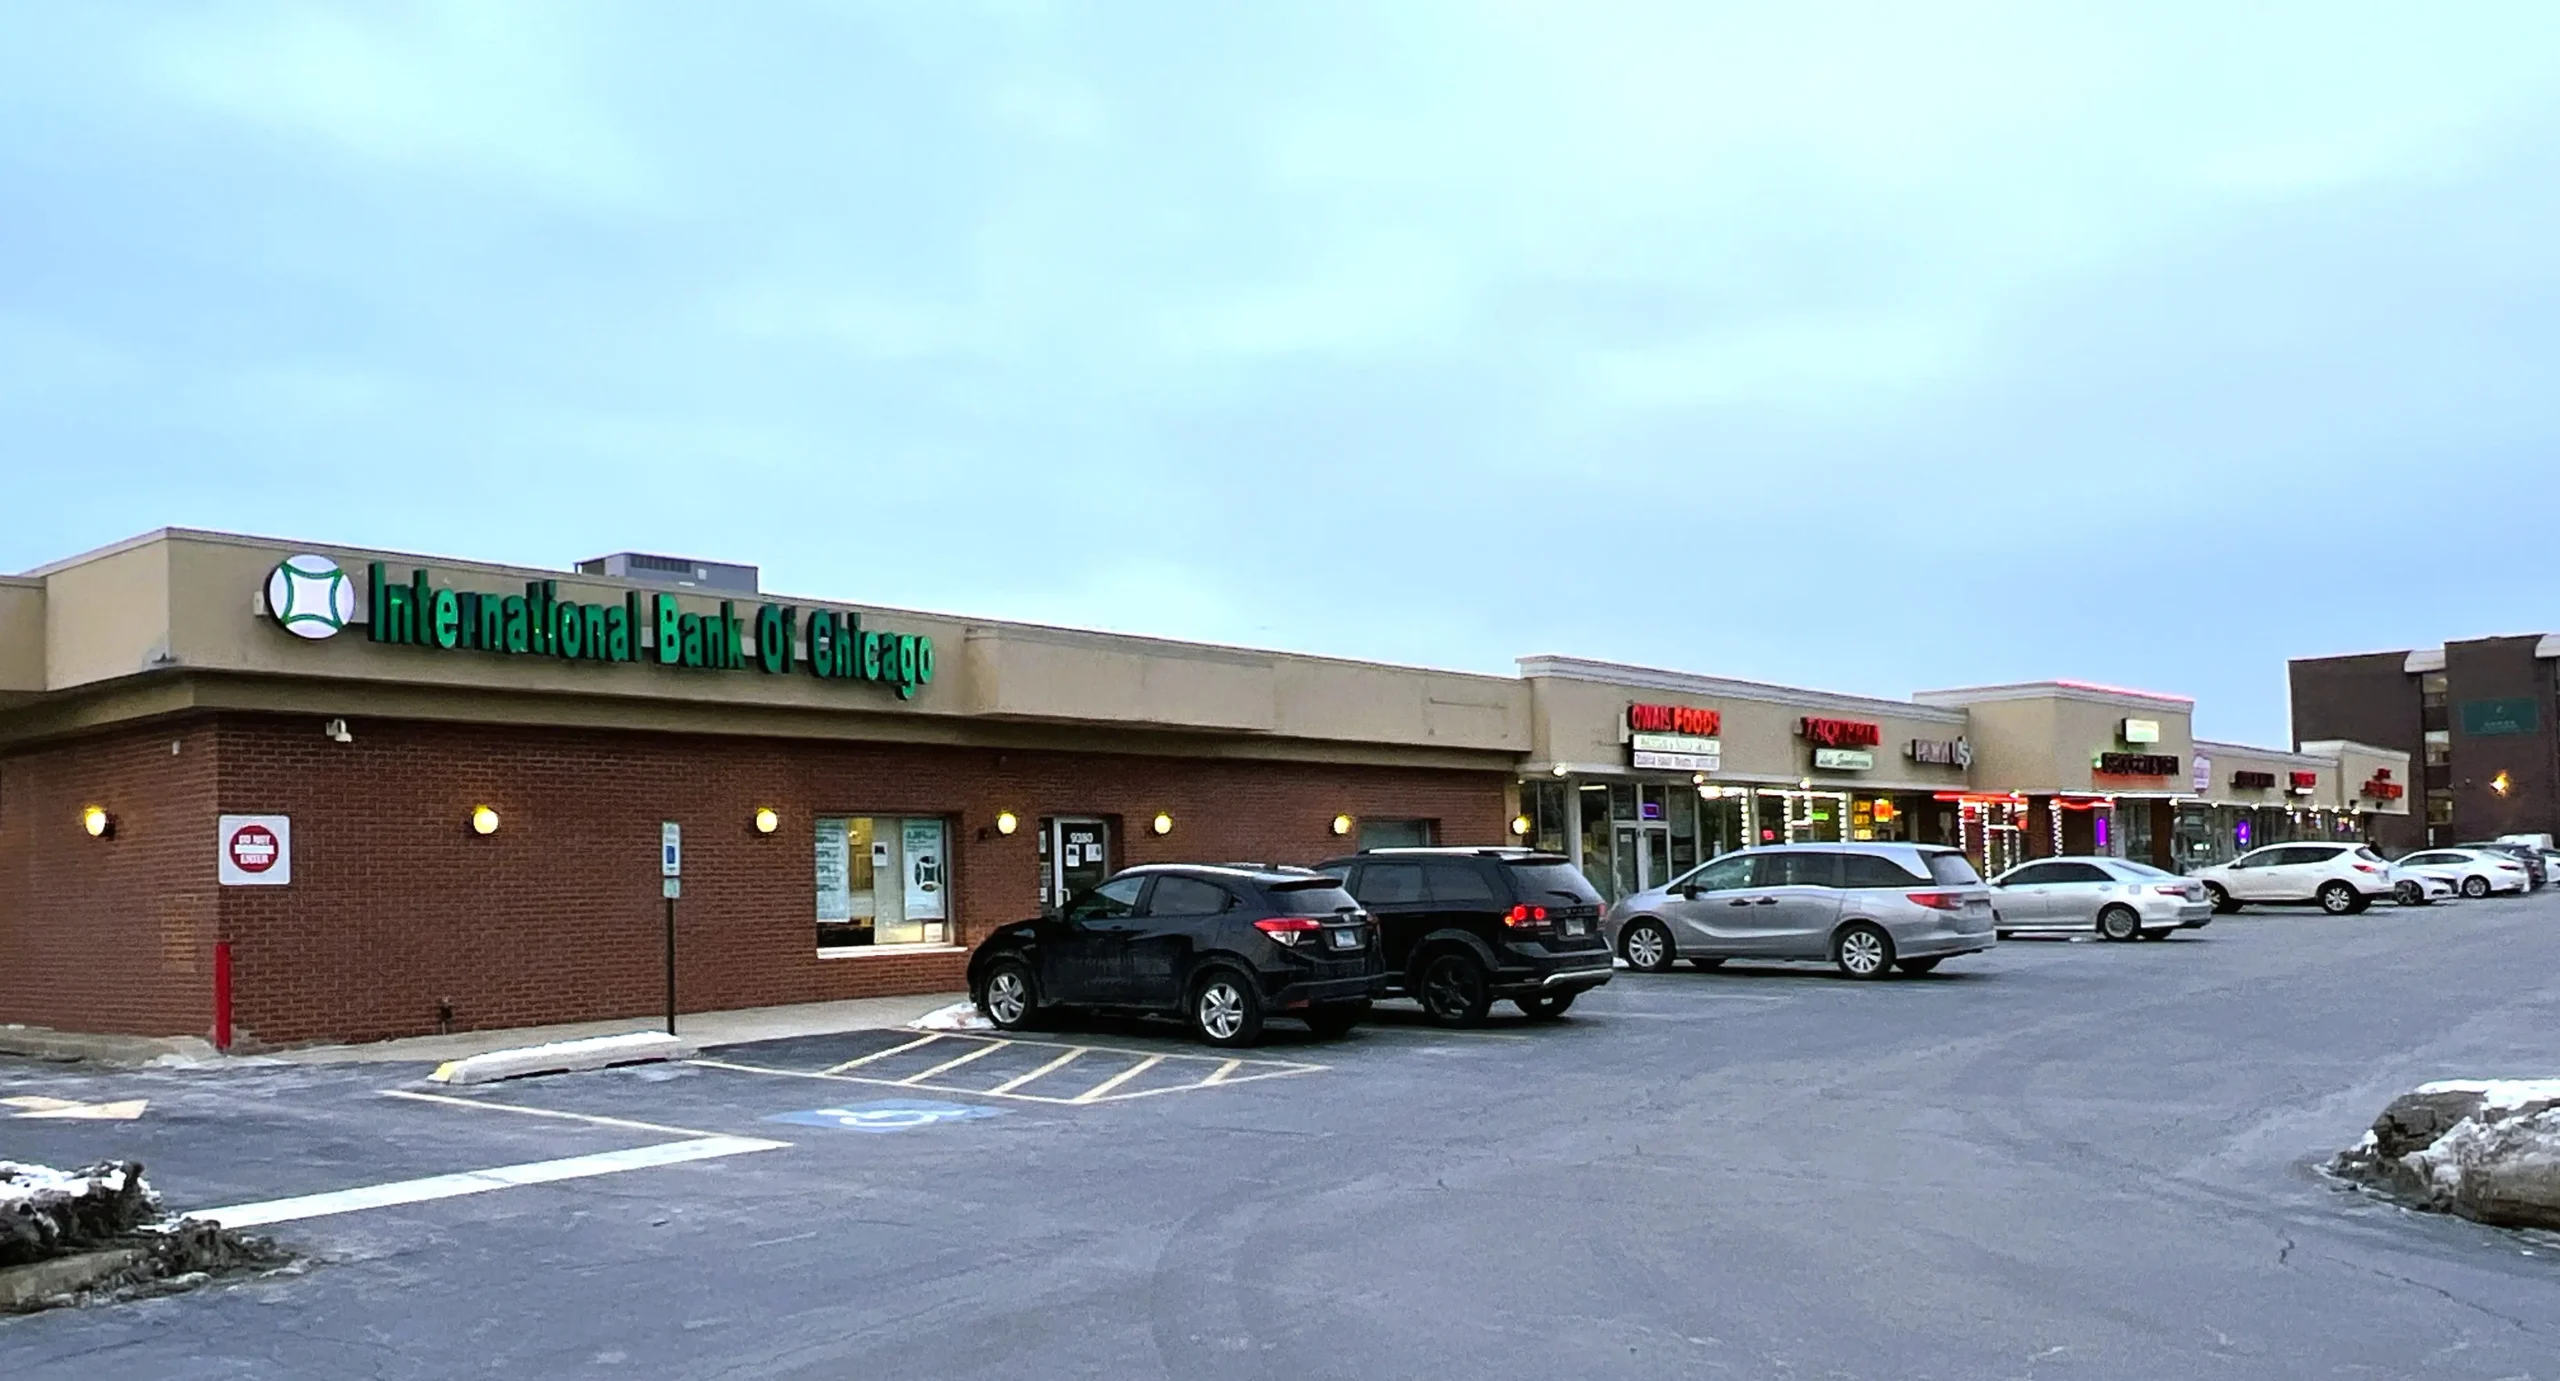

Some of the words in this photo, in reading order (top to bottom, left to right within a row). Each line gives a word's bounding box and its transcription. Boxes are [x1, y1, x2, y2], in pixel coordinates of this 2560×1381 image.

[368, 560, 642, 664] International
[653, 592, 747, 670] Bank
[755, 602, 797, 674] Of
[807, 608, 935, 700] Chicago
[1674, 707, 1721, 736] FOODS
